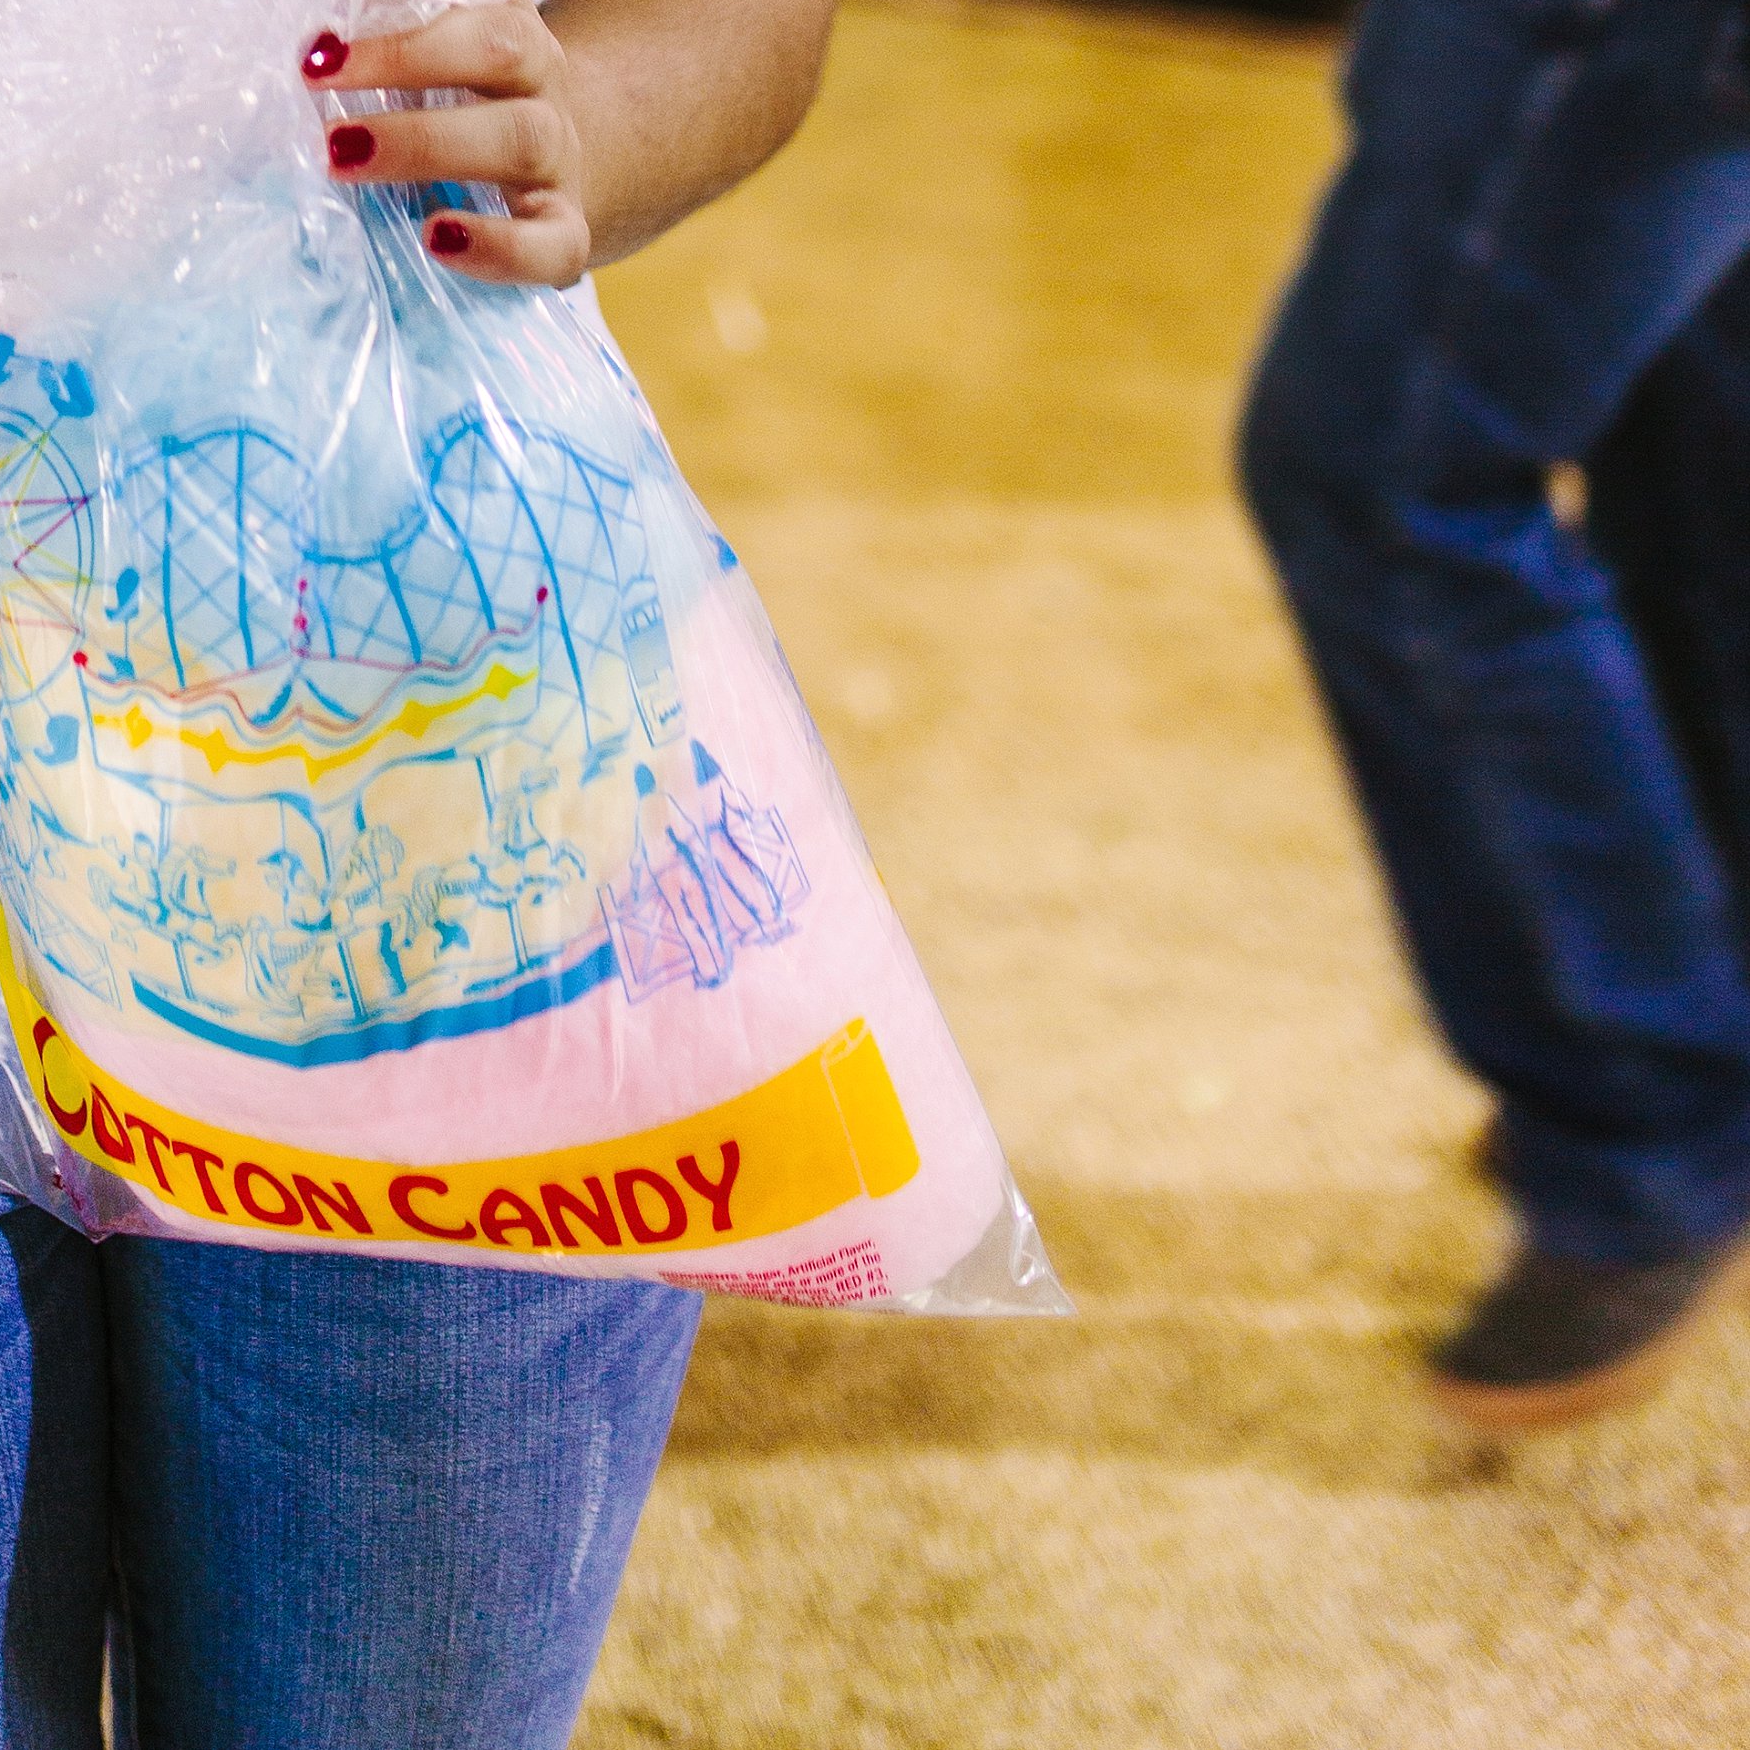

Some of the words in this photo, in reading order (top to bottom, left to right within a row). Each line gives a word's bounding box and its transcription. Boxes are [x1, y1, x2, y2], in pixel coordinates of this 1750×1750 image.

[33, 1016, 375, 1235] COTTON
[389, 1140, 741, 1248] CANDY
[788, 1252, 836, 1275] Artificial
[815, 1266, 844, 1284] more
[848, 1258, 859, 1271] of
[861, 1252, 881, 1266] the
[835, 1274, 862, 1292] RED
